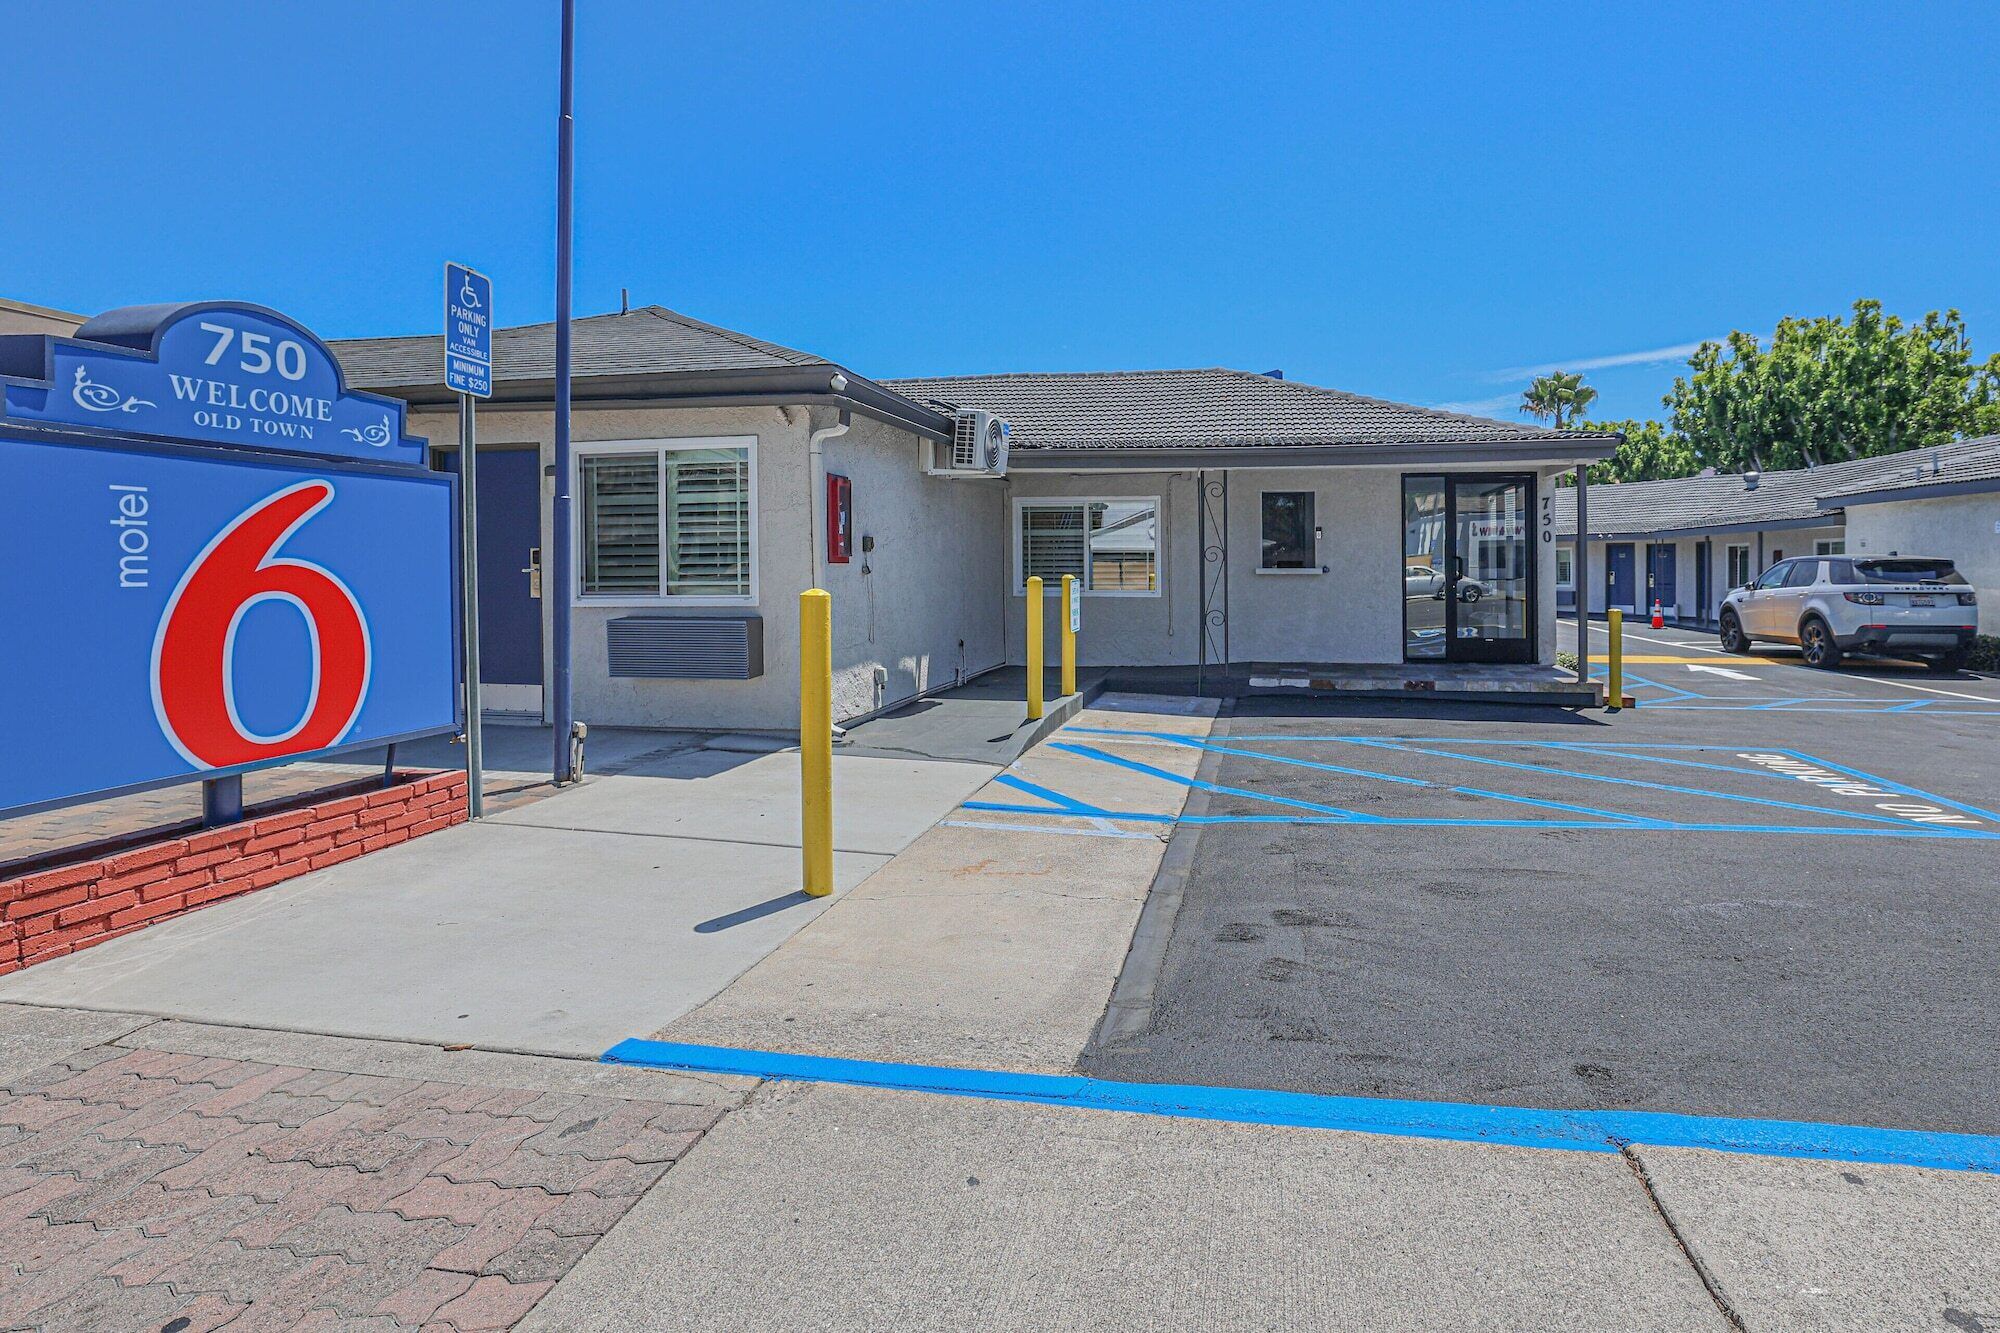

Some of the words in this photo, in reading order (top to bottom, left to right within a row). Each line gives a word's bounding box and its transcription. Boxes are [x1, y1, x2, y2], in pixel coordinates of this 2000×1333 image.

[451, 304, 486, 327] PARKING
[458, 321, 480, 338] ONLY
[200, 322, 307, 381] 750
[450, 342, 488, 360] ACCESSIBLE
[462, 337, 476, 347] VAN
[453, 360, 485, 378] MINIMUM
[449, 372, 466, 386] FINE
[468, 376, 488, 392] $250
[168, 374, 333, 422] WELCOME
[193, 411, 241, 430] OLD
[249, 418, 313, 439] TOWN
[1542, 497, 1552, 543] 750
[109, 485, 148, 588] motel
[150, 479, 371, 771] 6
[1874, 803, 1983, 824] NO
